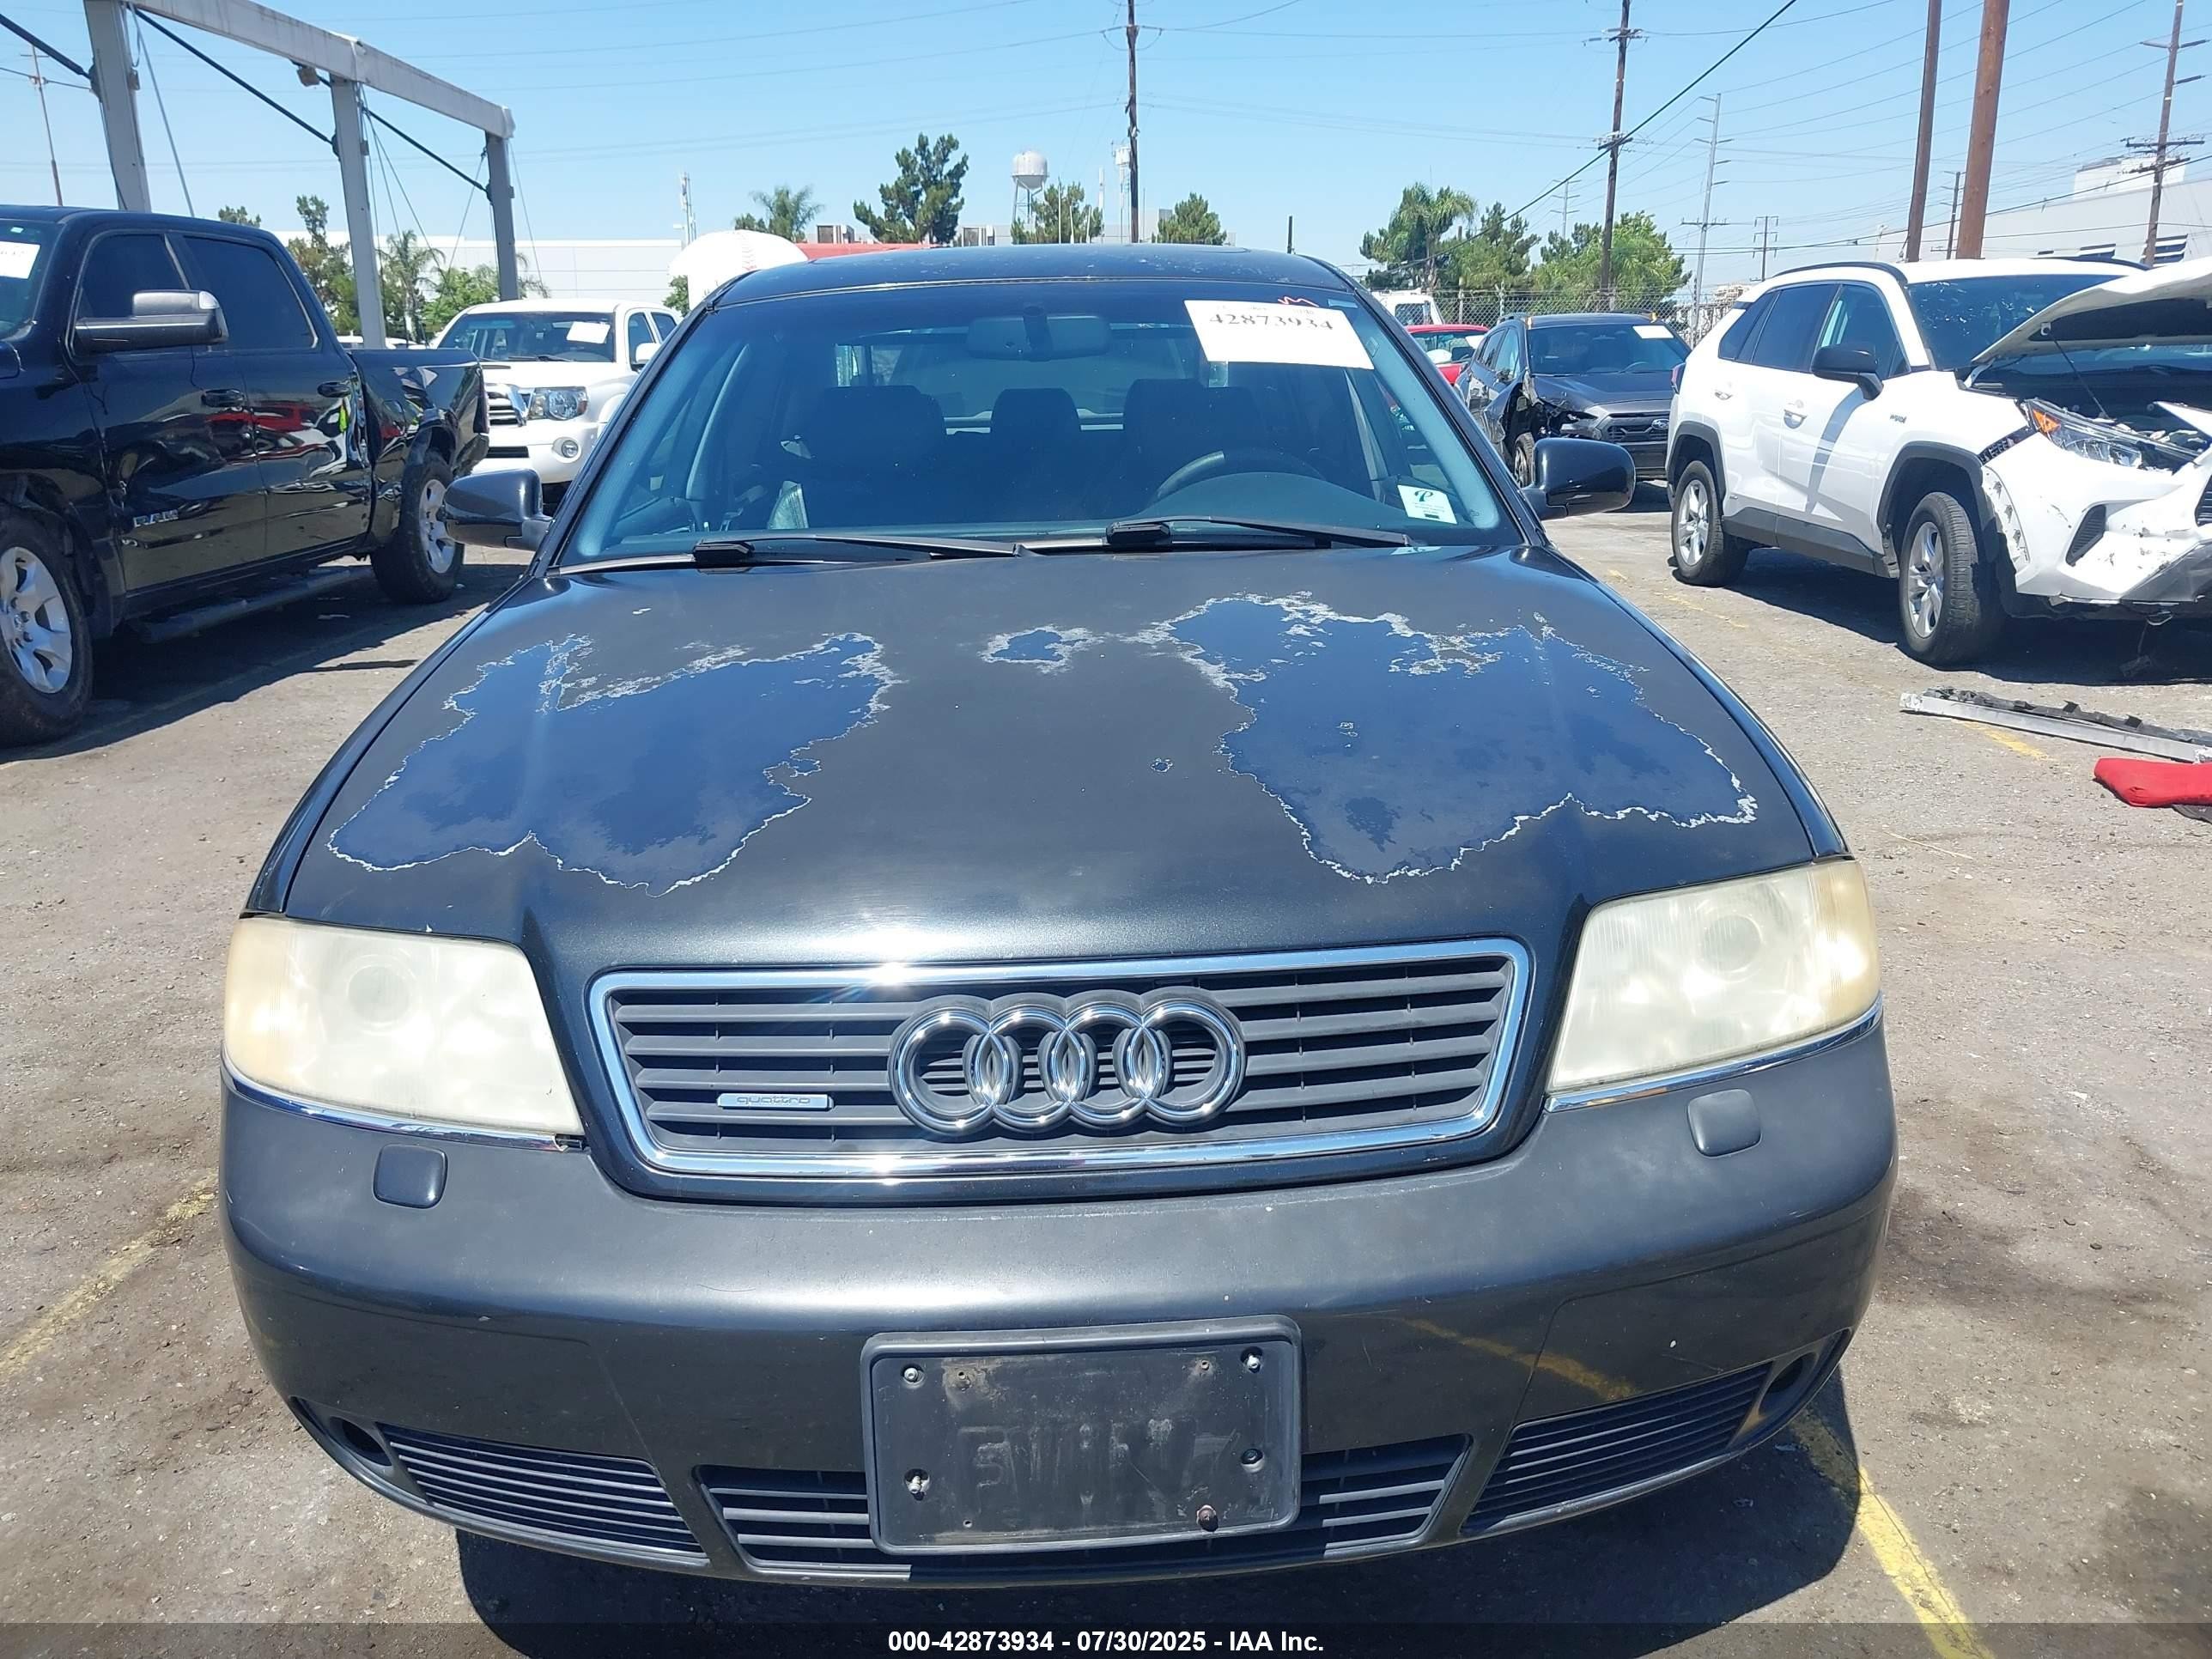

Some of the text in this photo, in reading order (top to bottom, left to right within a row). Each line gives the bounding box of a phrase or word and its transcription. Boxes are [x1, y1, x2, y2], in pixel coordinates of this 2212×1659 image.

[1210, 313, 1334, 331] 42873934
[132, 509, 179, 528] RAM
[736, 1096, 811, 1105] quattro
